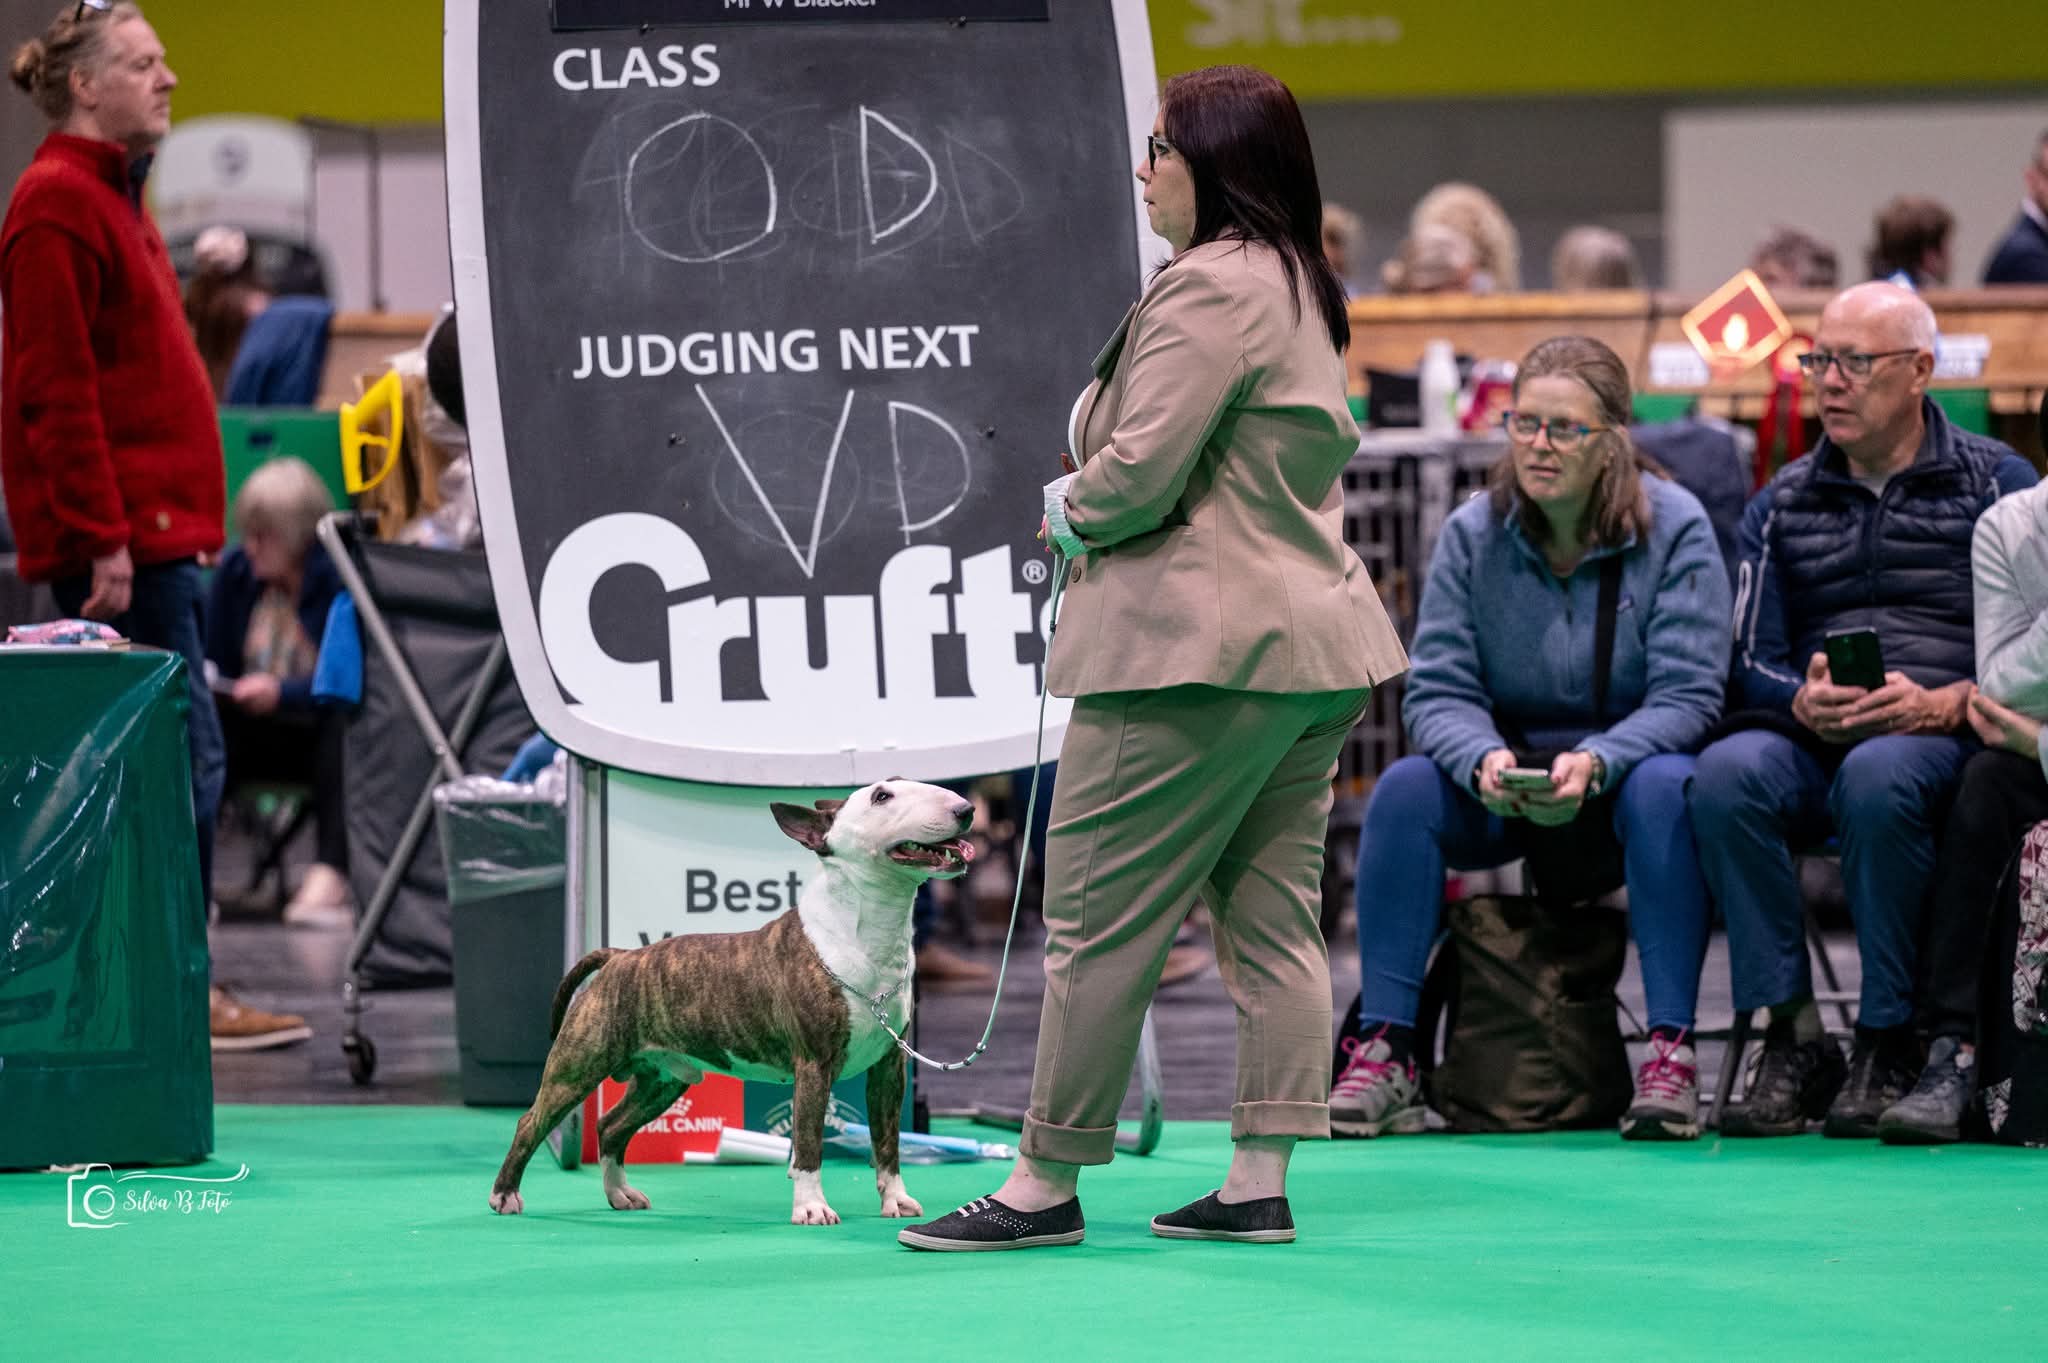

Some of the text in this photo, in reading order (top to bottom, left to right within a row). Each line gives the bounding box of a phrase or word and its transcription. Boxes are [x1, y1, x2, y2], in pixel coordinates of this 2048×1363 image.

[552, 43, 721, 91] CLASS
[573, 325, 979, 379] JUDGING NEXT
[686, 868, 803, 914] Best
[672, 1116, 723, 1133] CANIN
